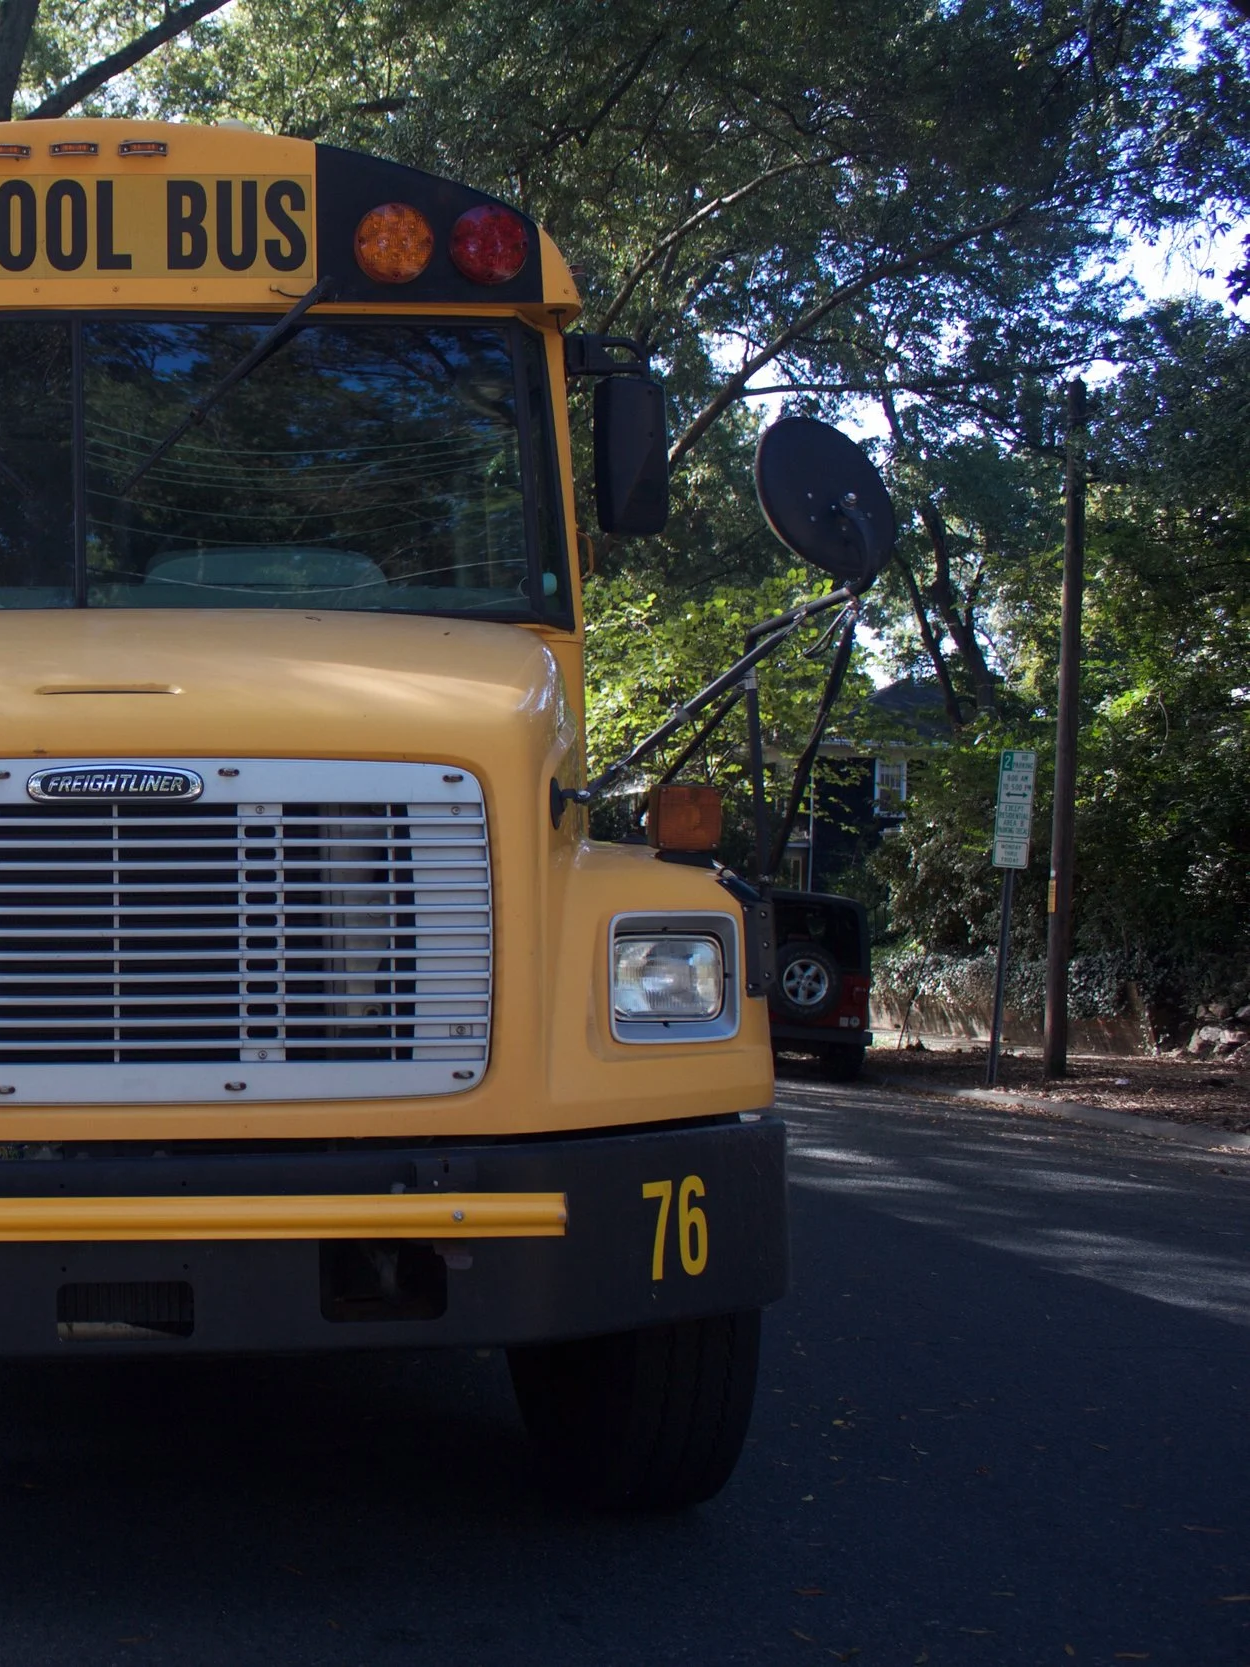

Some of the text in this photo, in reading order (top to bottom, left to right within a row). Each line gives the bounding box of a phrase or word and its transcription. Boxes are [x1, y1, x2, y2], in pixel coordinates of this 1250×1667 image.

[166, 180, 307, 272] BUS
[47, 774, 184, 793] FREIGHTLINER
[1004, 755, 1011, 768] 2
[642, 1175, 708, 1281] 76
